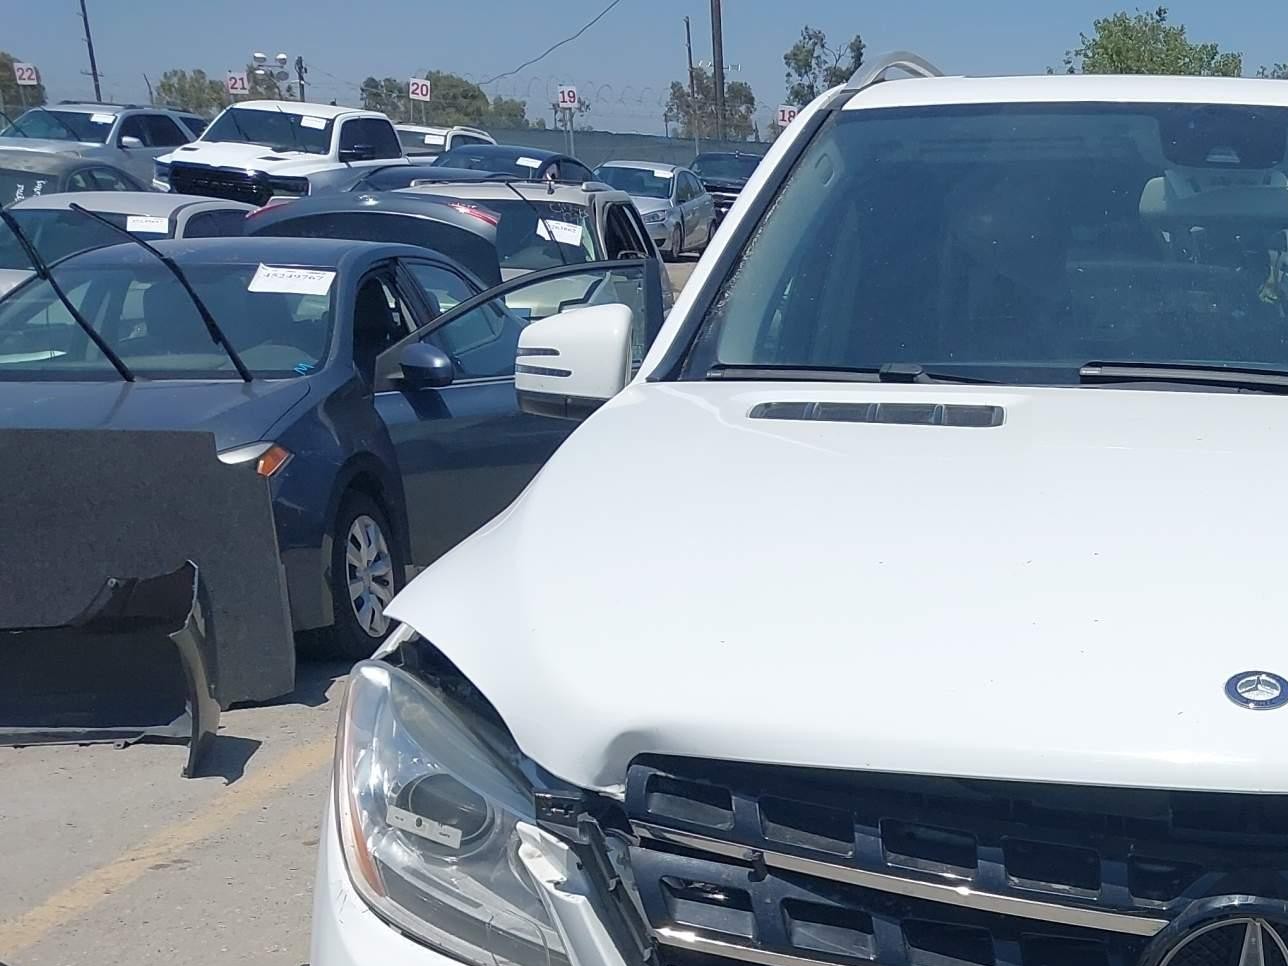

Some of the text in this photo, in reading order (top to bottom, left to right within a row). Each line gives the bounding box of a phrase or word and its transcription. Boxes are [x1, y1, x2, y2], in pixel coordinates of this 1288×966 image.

[16, 67, 36, 81] 22
[229, 77, 247, 90] 21
[411, 82, 429, 97] 20
[560, 90, 576, 104] 19
[779, 110, 796, 123] 18
